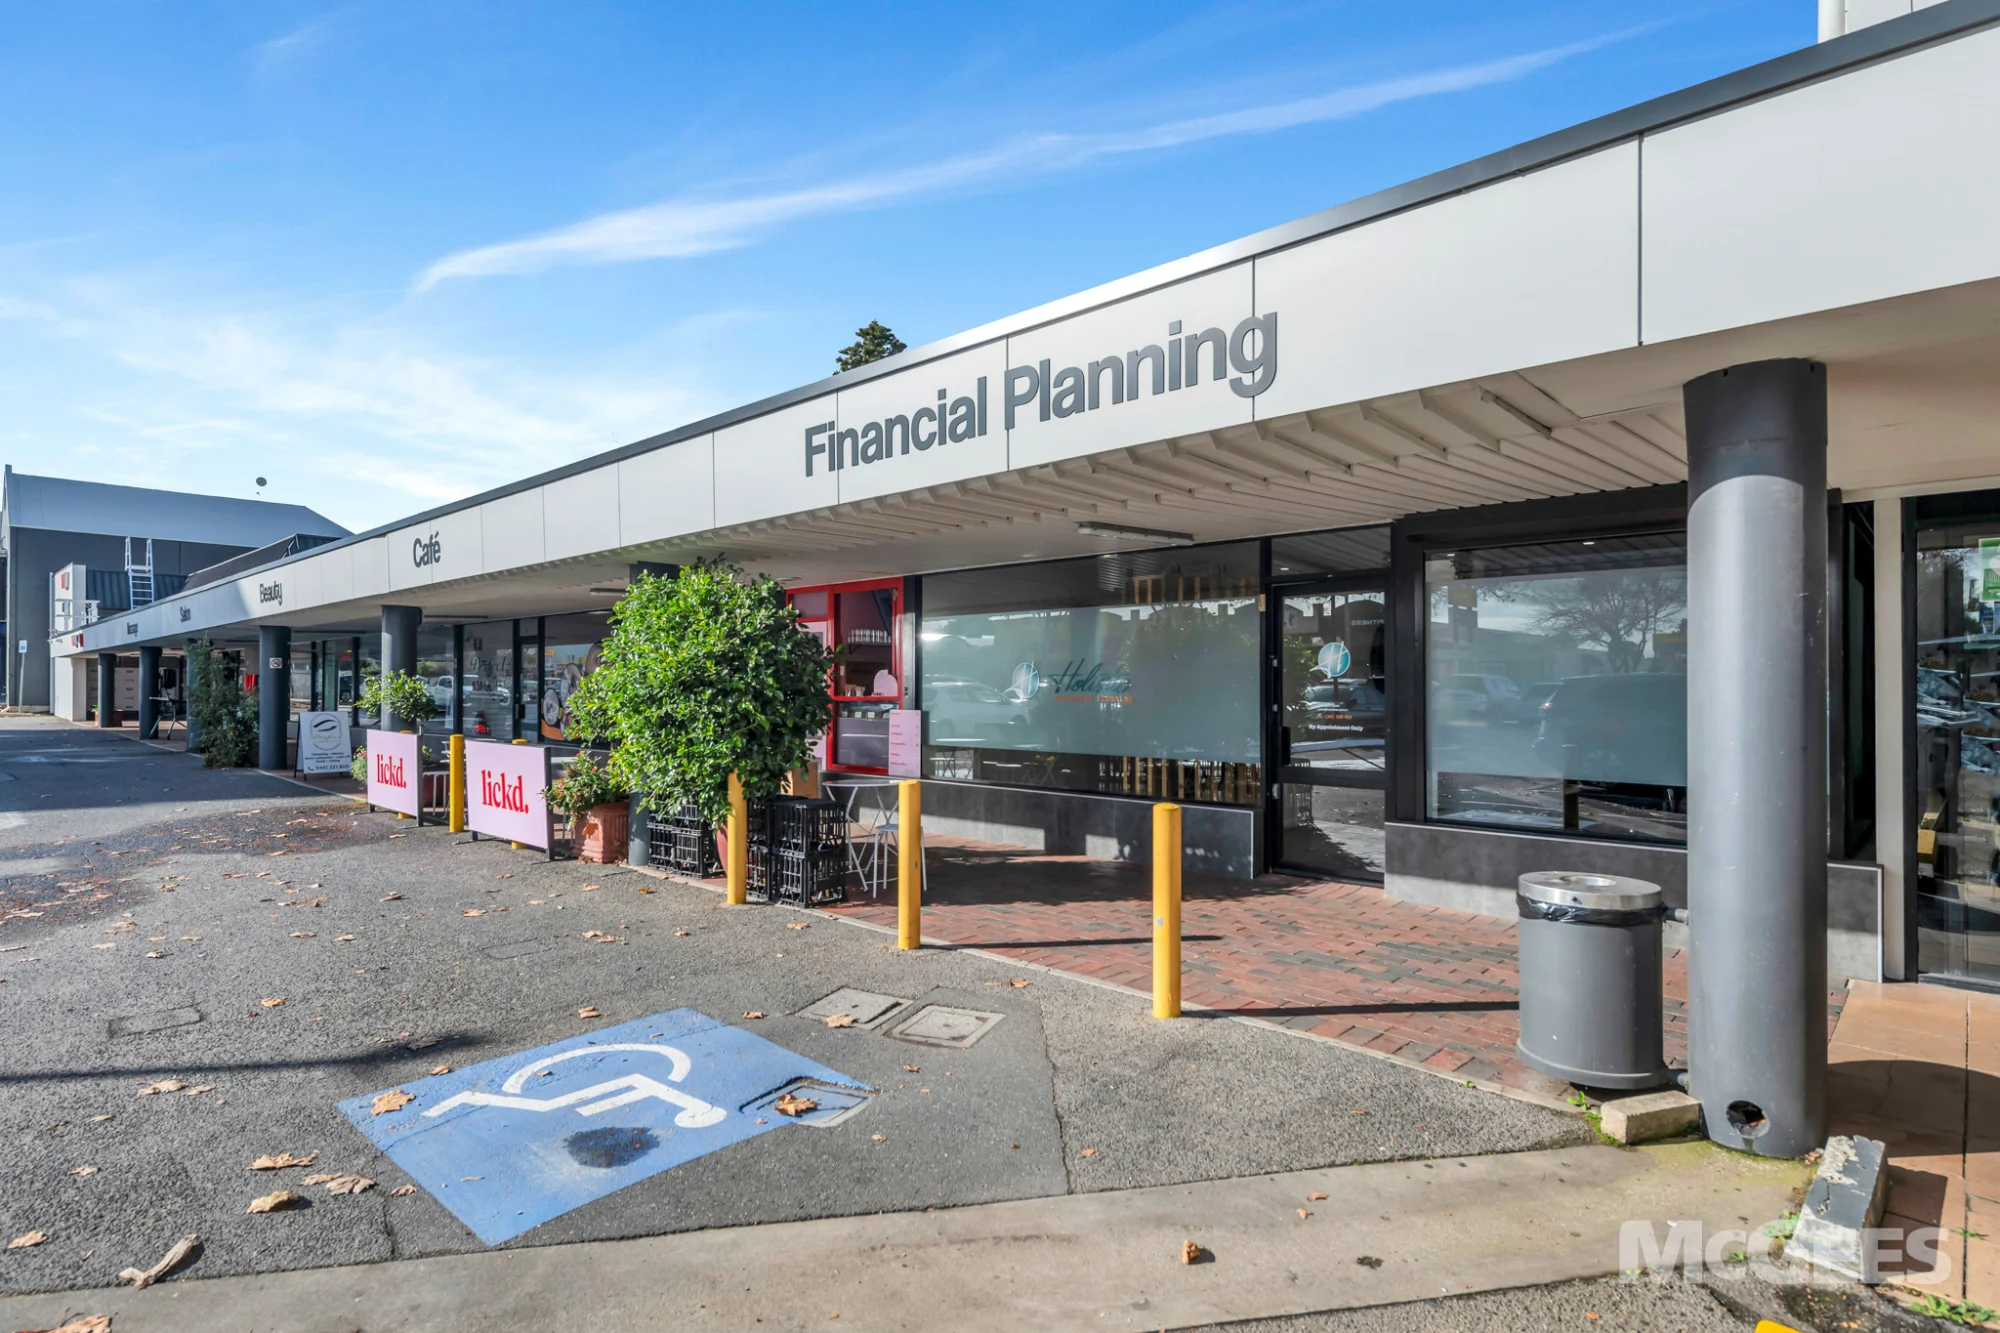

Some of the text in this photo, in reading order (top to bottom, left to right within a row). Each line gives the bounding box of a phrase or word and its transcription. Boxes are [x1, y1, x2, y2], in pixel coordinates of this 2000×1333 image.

[805, 311, 1278, 478] Financial Planning
[413, 530, 441, 568] Café
[260, 581, 282, 606] Beauty
[376, 753, 407, 789] lickd.
[481, 769, 529, 814] lickd.
